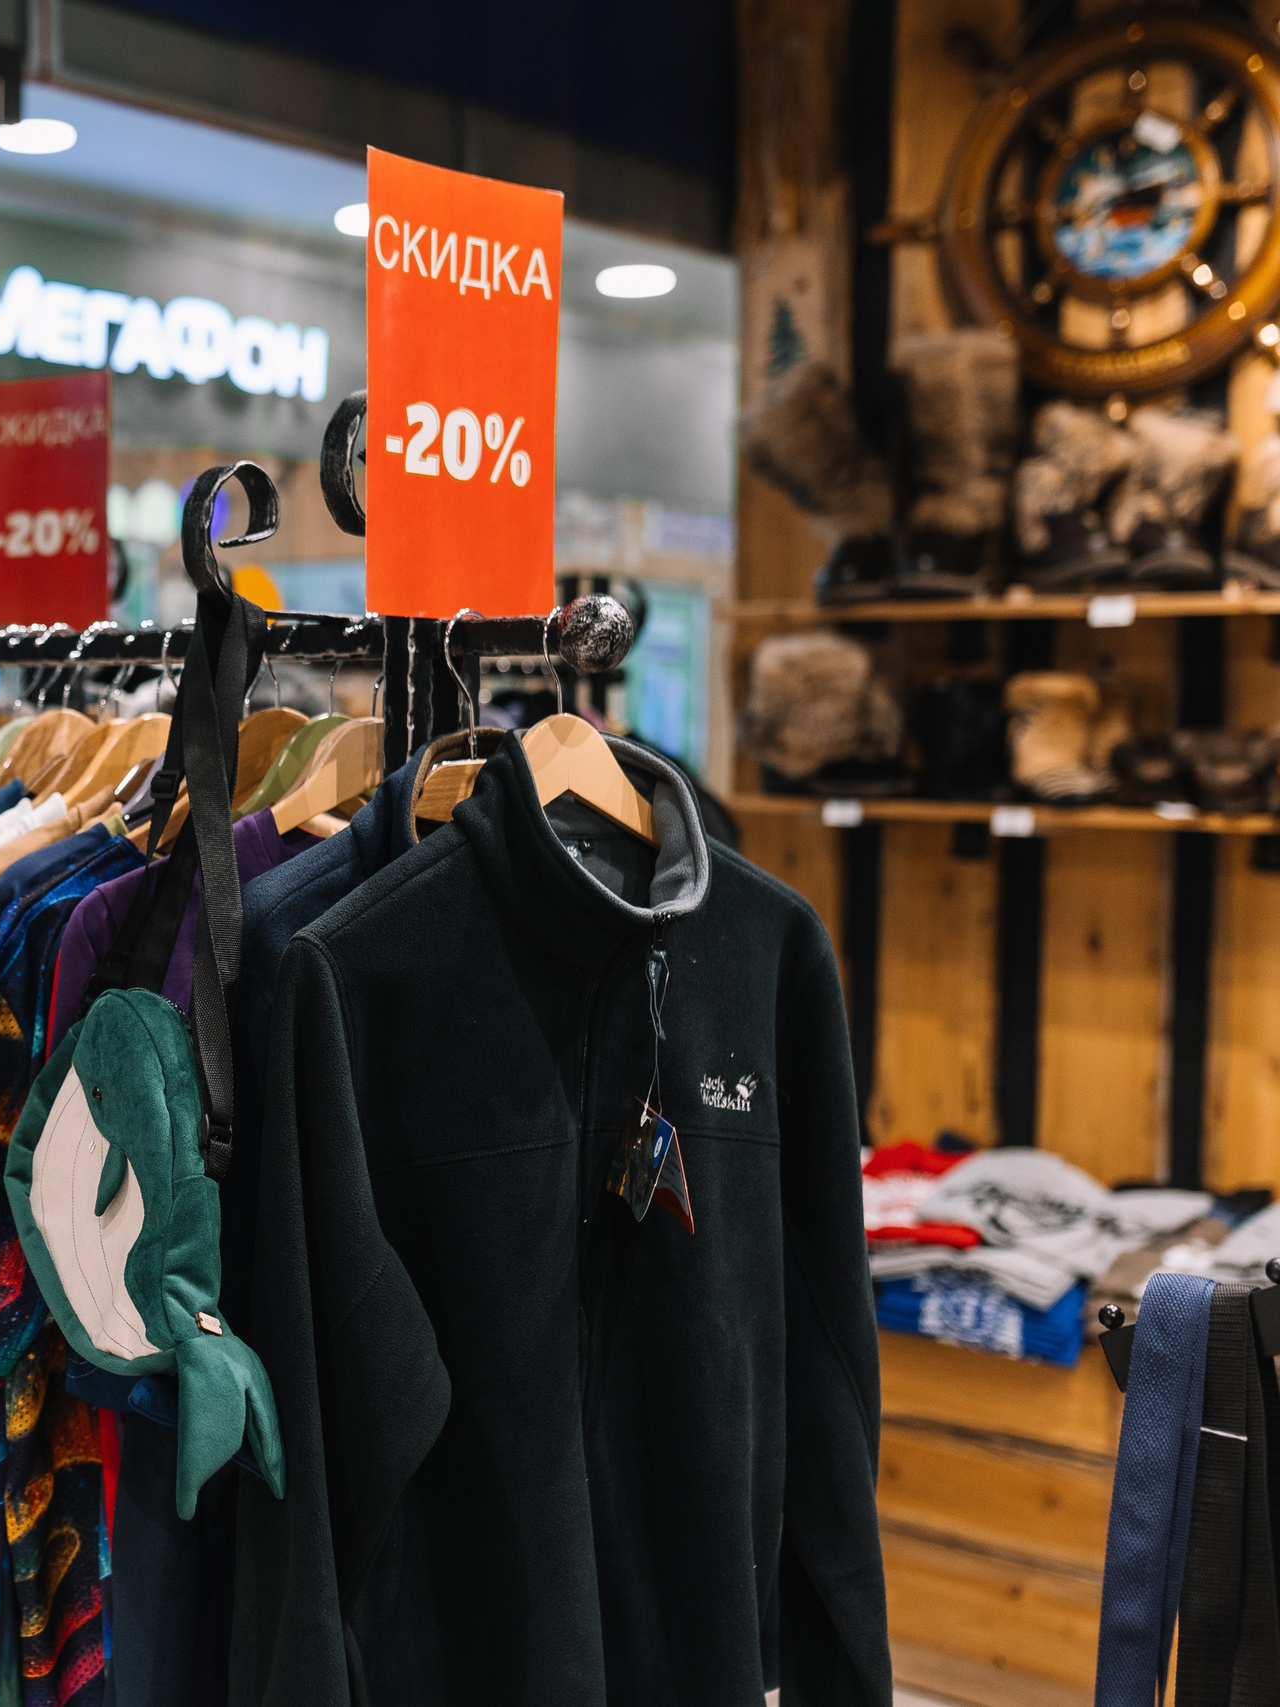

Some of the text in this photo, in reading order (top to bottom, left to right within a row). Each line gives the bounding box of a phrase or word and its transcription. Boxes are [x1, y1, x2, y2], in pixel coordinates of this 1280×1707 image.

[373, 214, 554, 301] СКИДКА
[385, 401, 531, 487] -20%
[700, 1073, 726, 1092] Jack
[700, 1088, 751, 1112] Wolfskin
